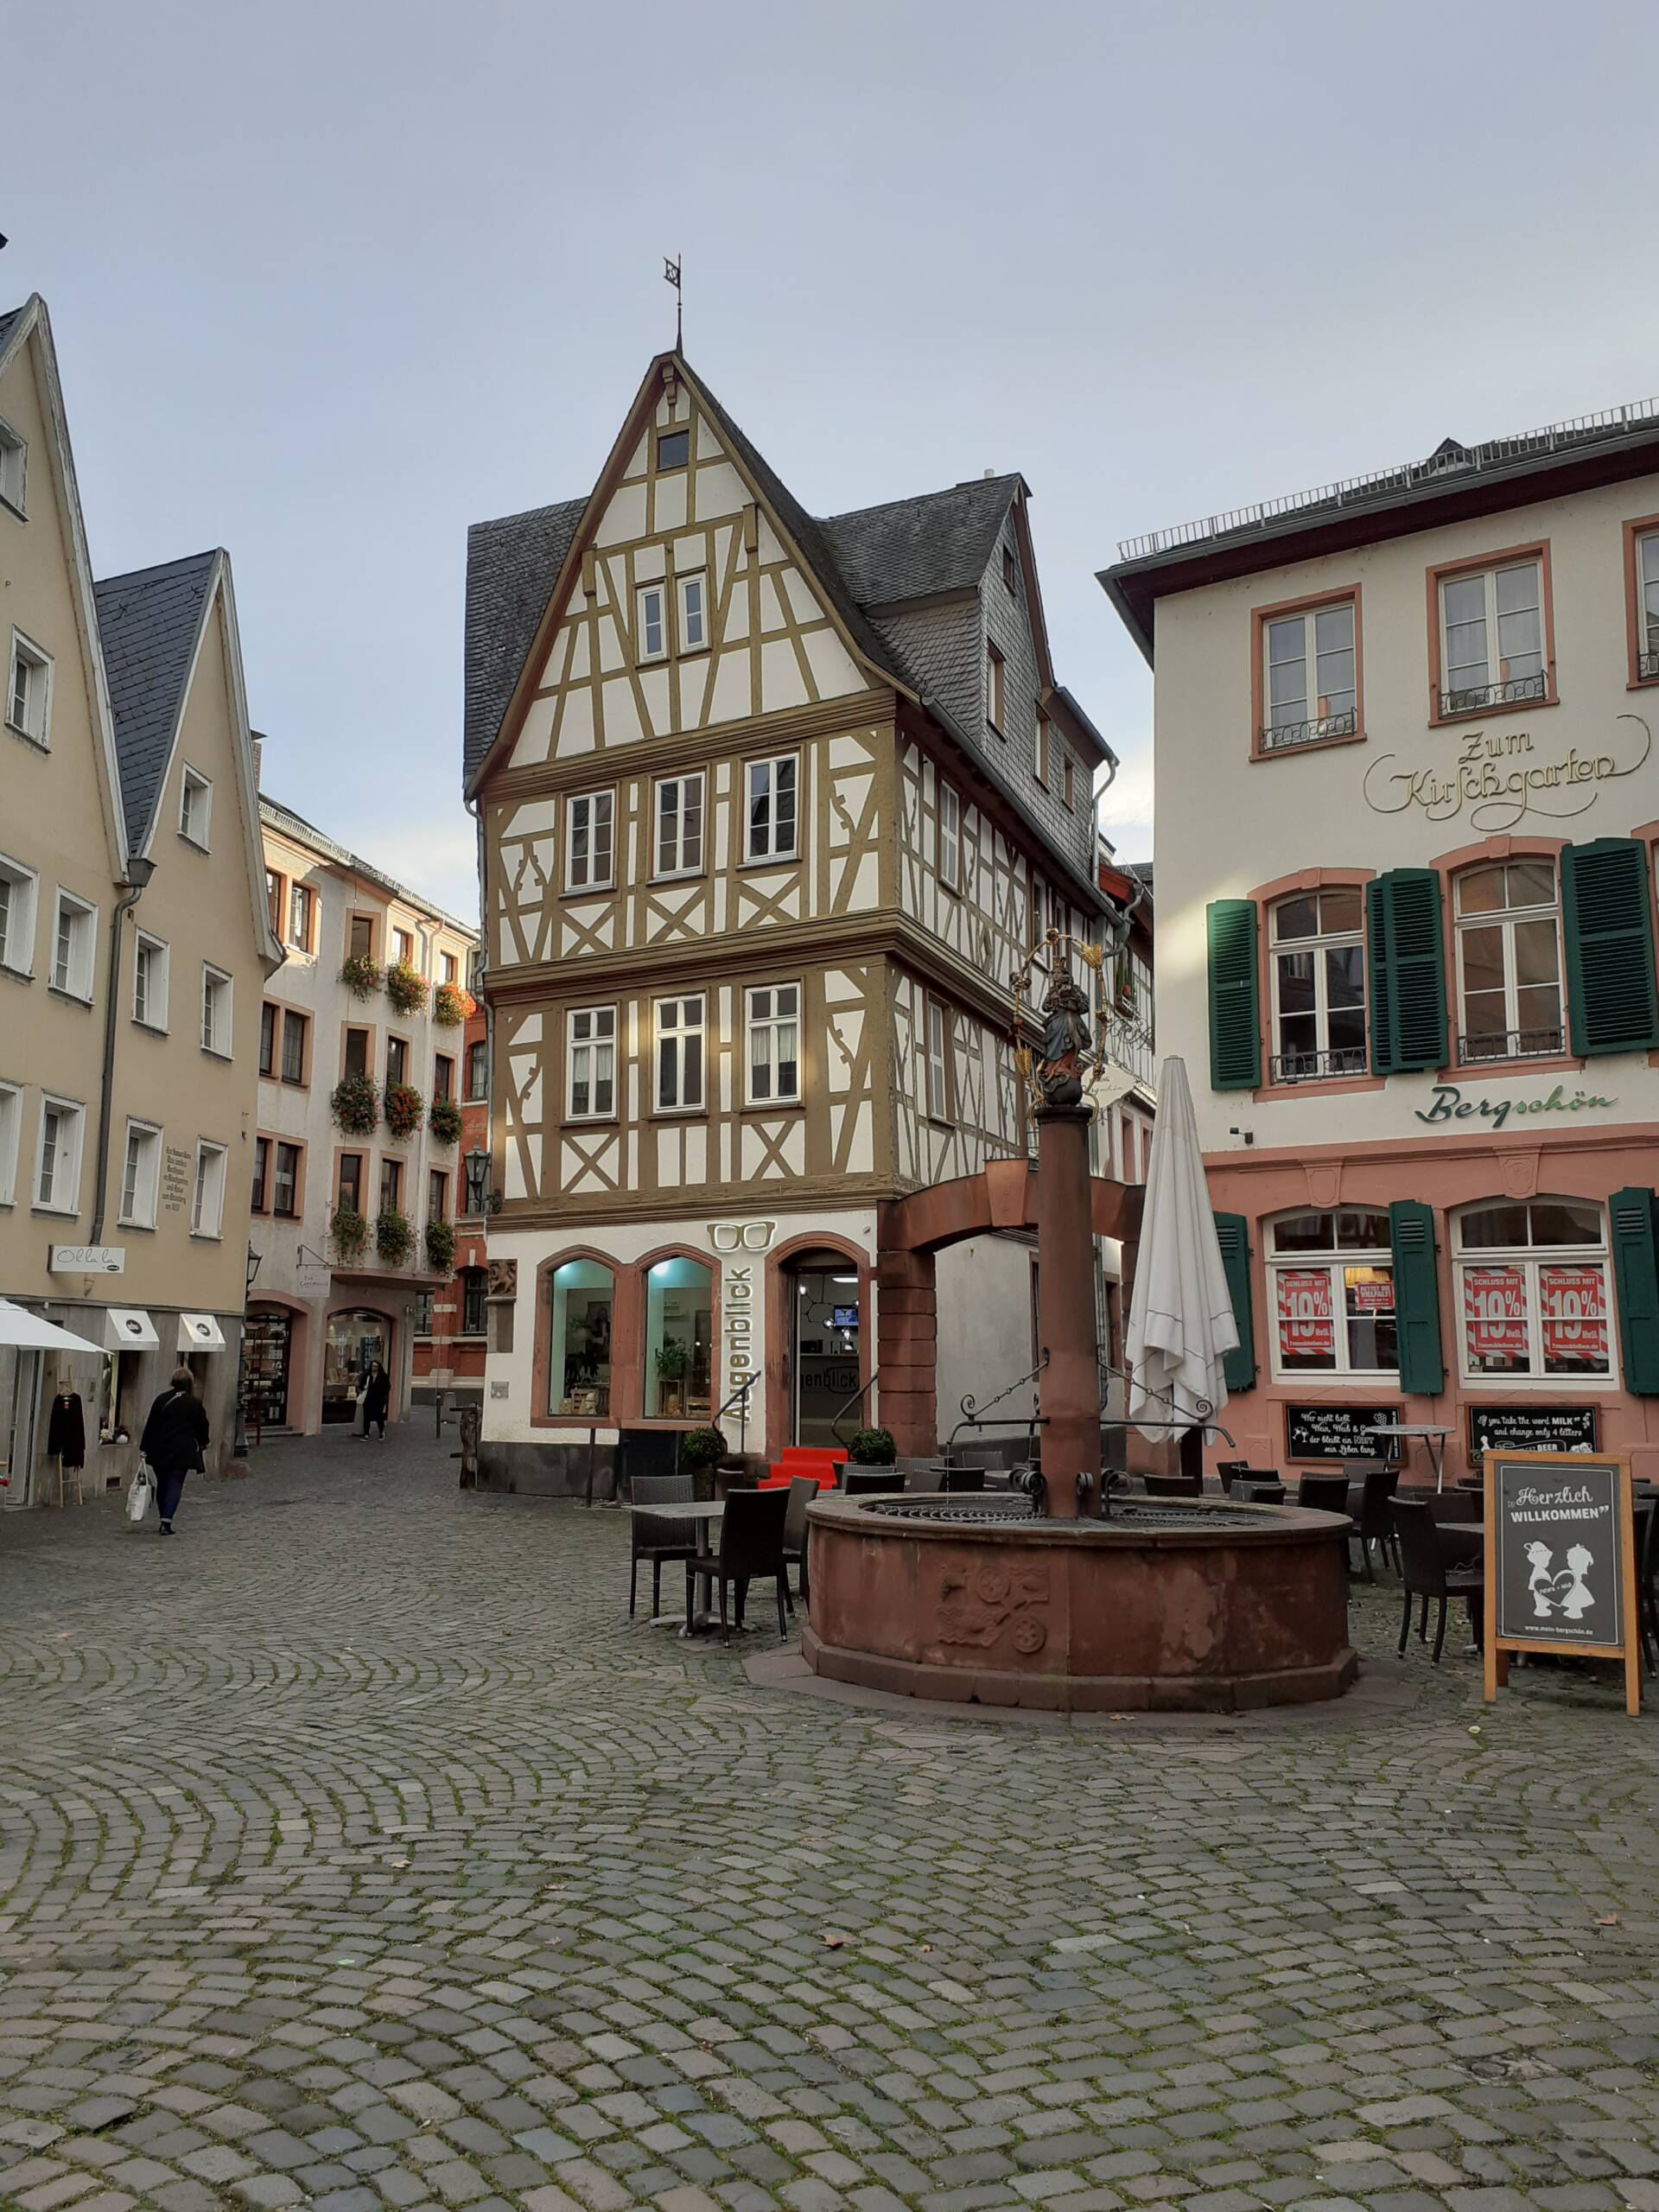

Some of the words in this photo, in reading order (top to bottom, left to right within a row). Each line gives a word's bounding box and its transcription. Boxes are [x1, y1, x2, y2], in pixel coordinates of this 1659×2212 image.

[1458, 731, 1535, 764] Zum
[1414, 1084, 1619, 1128] Bergschön
[1473, 1277, 1505, 1286] SCHLUSS
[723, 1267, 752, 1422] Augenblick
[1488, 1417, 1502, 1427] you
[1517, 1415, 1530, 1425] the
[1531, 1416, 1550, 1425] word
[1493, 1427, 1508, 1436] and
[1536, 1443, 1558, 1452] BEER
[1516, 1485, 1593, 1506] Herzlich
